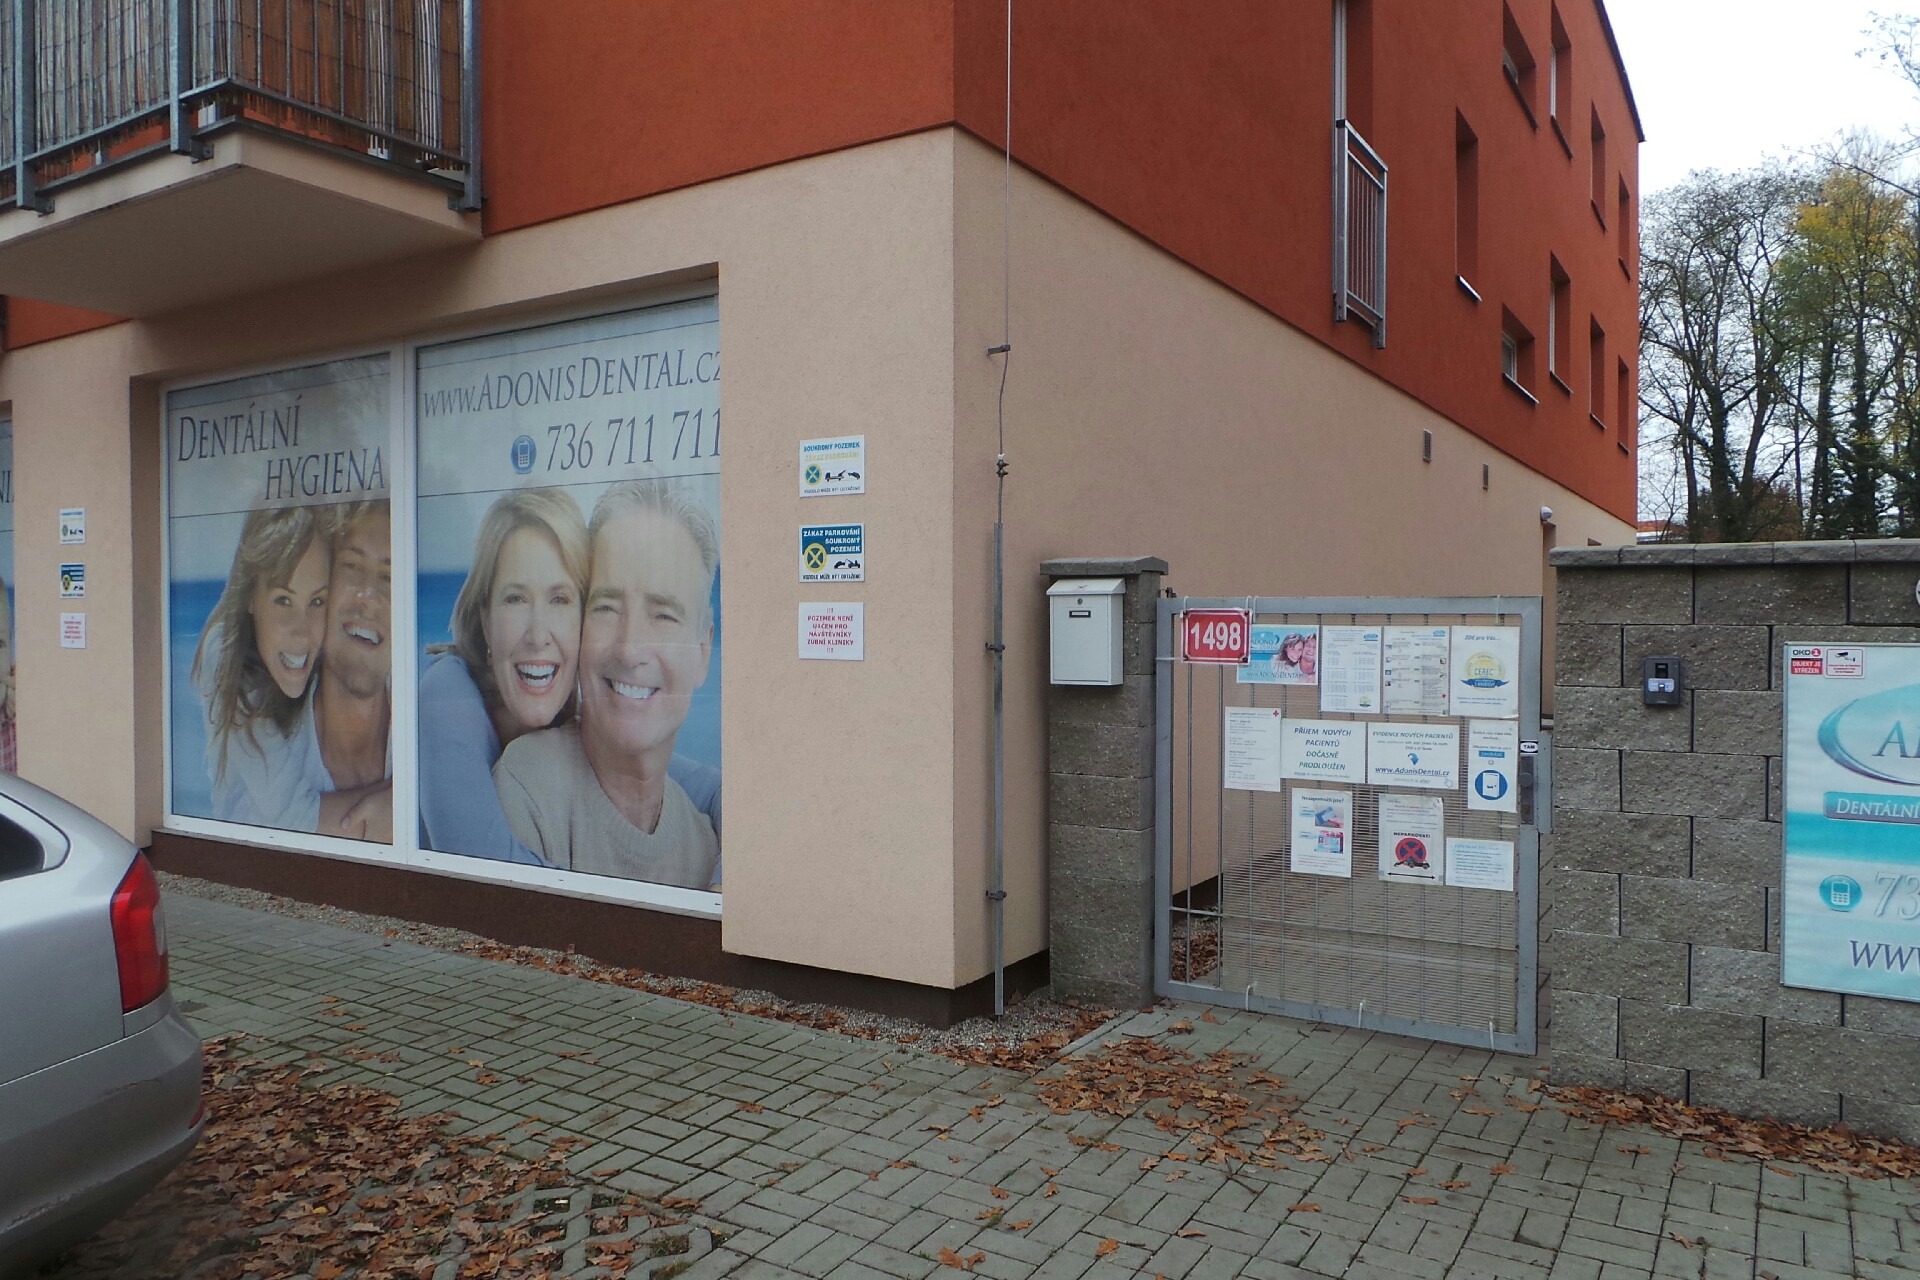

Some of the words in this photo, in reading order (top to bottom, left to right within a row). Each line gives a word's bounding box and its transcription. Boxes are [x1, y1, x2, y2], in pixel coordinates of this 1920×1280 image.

[178, 394, 303, 462] DENTÁLNÍ
[547, 421, 594, 471] 736
[607, 414, 655, 466] 711
[672, 407, 720, 461] 711
[266, 446, 386, 500] HYGIENA
[803, 529, 824, 537] ZÁKAZ
[824, 527, 861, 536] PARKOVÁNÍ
[825, 536, 861, 544] SOUKROMÝ
[830, 545, 861, 553] POZEMEK
[1190, 621, 1241, 651] 1498
[1474, 667, 1495, 676] CEREC
[1322, 728, 1352, 736] NOVÝCH
[1305, 739, 1341, 748] PACIENTŮ
